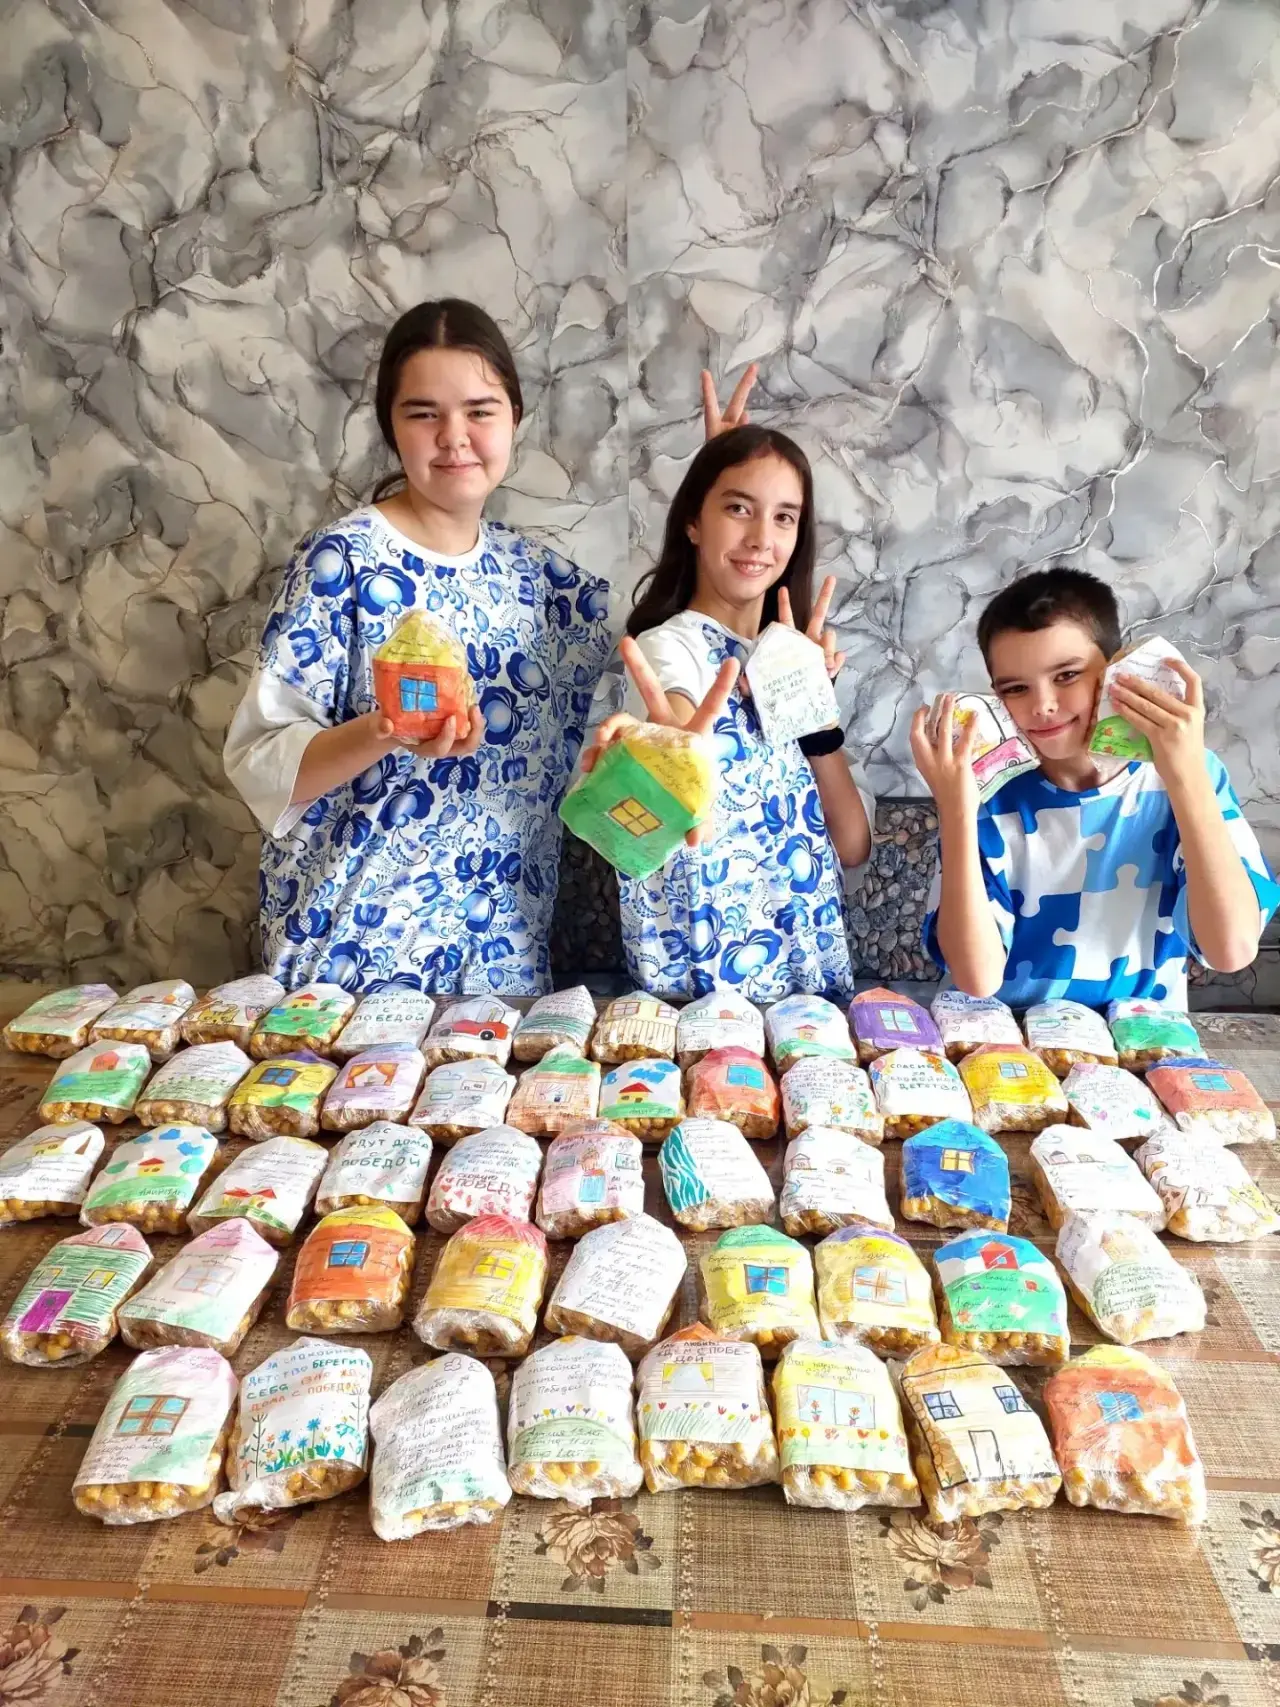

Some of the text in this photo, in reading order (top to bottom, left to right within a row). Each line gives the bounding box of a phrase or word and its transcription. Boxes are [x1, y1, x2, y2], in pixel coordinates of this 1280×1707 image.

[363, 997, 430, 1005] ЖДУТ ДОМА
[353, 1013, 424, 1023] ПОБЕДОЙ
[347, 1137, 429, 1150] ЖДУТ ДОМА
[341, 1153, 420, 1170] ПОБЕДОЙ
[456, 1178, 522, 1196] ПОБЕДУ
[249, 1357, 370, 1386] ДЕТСТВО БЕРЕГИТЕ
[266, 1362, 278, 1371] ЗА
[246, 1383, 289, 1400] СЕБЯ
[340, 1368, 366, 1379] ЖДУ
[249, 1395, 286, 1412] ДОМА
